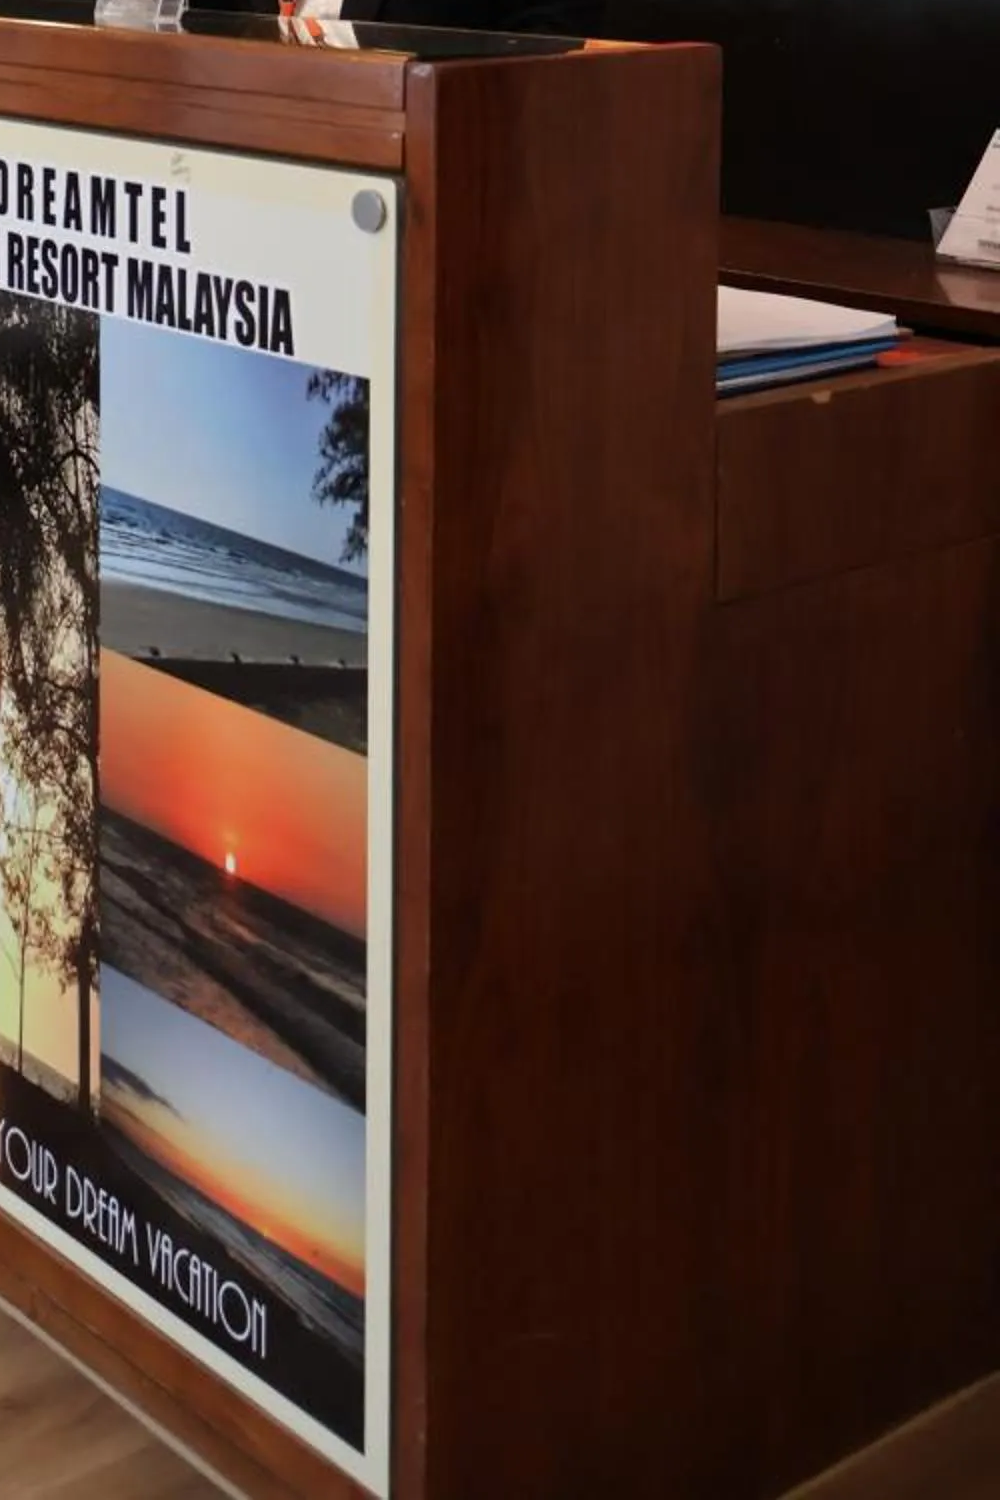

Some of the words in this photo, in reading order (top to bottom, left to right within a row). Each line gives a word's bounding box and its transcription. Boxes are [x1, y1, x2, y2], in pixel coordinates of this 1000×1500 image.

[6, 232, 119, 314] RESORT
[126, 258, 295, 357] MALAYSIA
[65, 1165, 139, 1265] DREAM
[146, 1221, 268, 1360] VACATION
